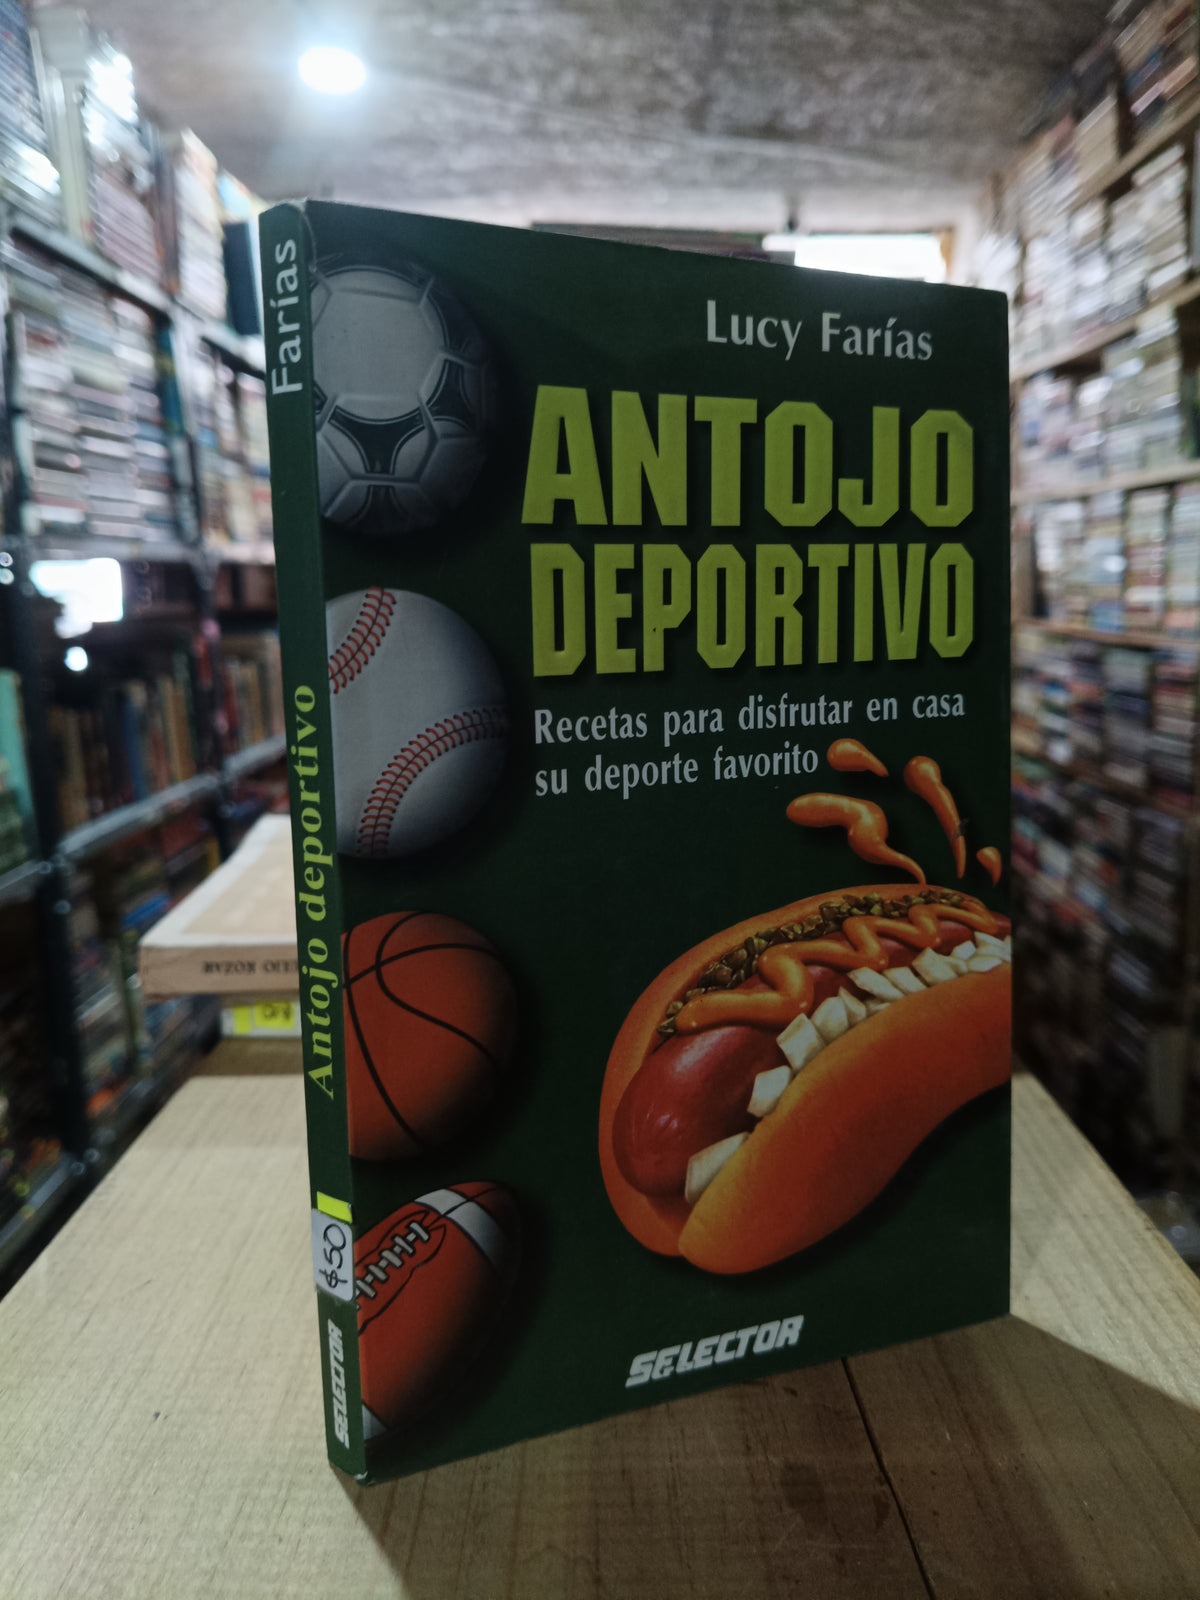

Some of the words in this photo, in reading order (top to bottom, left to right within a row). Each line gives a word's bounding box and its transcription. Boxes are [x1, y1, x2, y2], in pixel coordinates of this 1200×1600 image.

[270, 239, 303, 395] Farías
[707, 300, 802, 360] Lucy
[821, 311, 934, 361] Farías
[521, 384, 974, 528] ANTOJO
[530, 542, 974, 677] DEPORTIVO
[534, 707, 648, 744] Recetas
[663, 708, 725, 747] para
[738, 693, 853, 730] disfrutar
[866, 698, 899, 721] en
[912, 693, 966, 717] casa
[535, 766, 569, 796] su
[584, 755, 700, 799] deporte
[713, 741, 819, 781] favorito
[290, 685, 334, 921] deportivo
[302, 937, 339, 1100] Antojo
[327, 1319, 350, 1449] SELECTOR
[625, 1314, 805, 1388] SELECTOR
